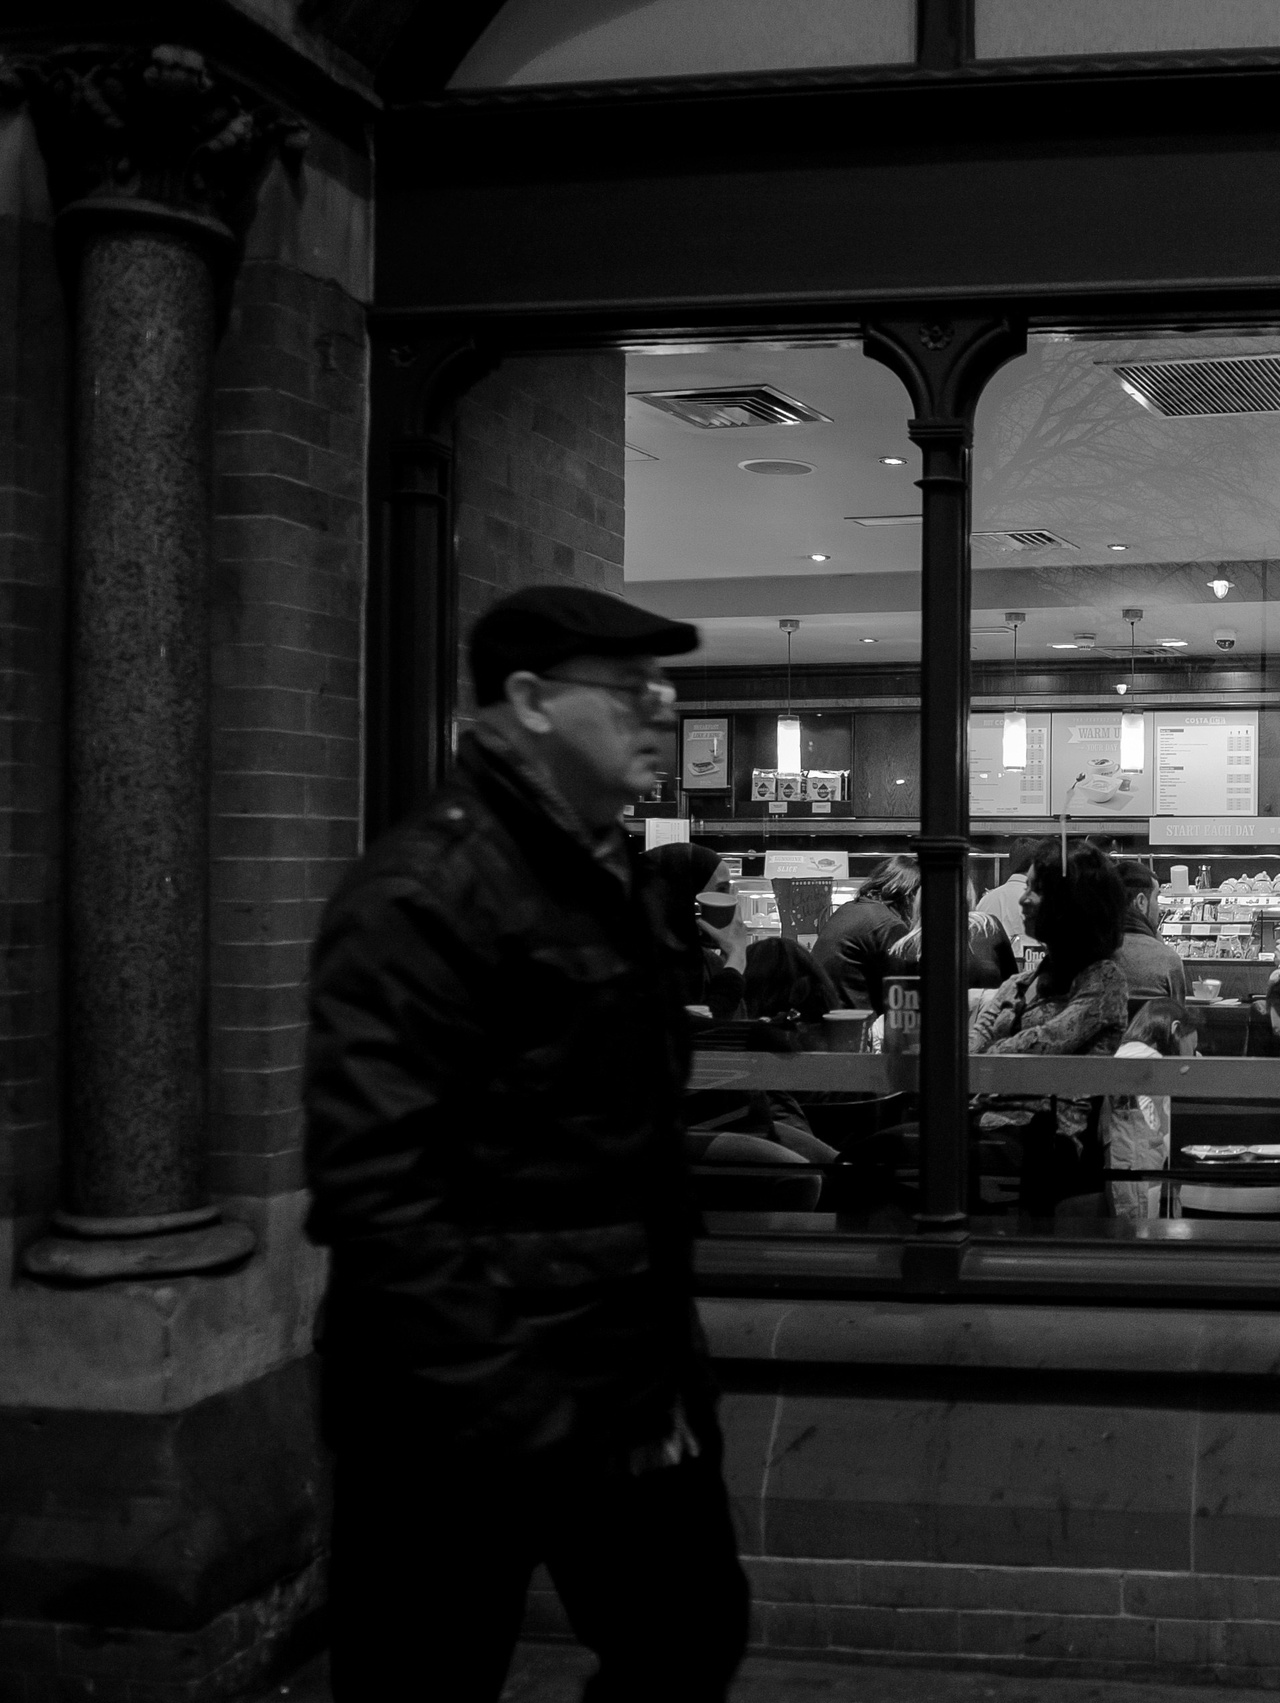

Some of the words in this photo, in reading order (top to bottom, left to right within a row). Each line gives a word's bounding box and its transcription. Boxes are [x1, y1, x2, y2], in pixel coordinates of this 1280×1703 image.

[1184, 717, 1209, 725] COSTA
[1078, 727, 1110, 739] WARM
[1105, 743, 1118, 752] DAY
[1166, 824, 1201, 837] START
[1204, 824, 1232, 837] EACH
[1235, 824, 1256, 837] DAY
[776, 865, 798, 873] SLICE
[888, 984, 920, 1010] On
[887, 1010, 921, 1034] up
